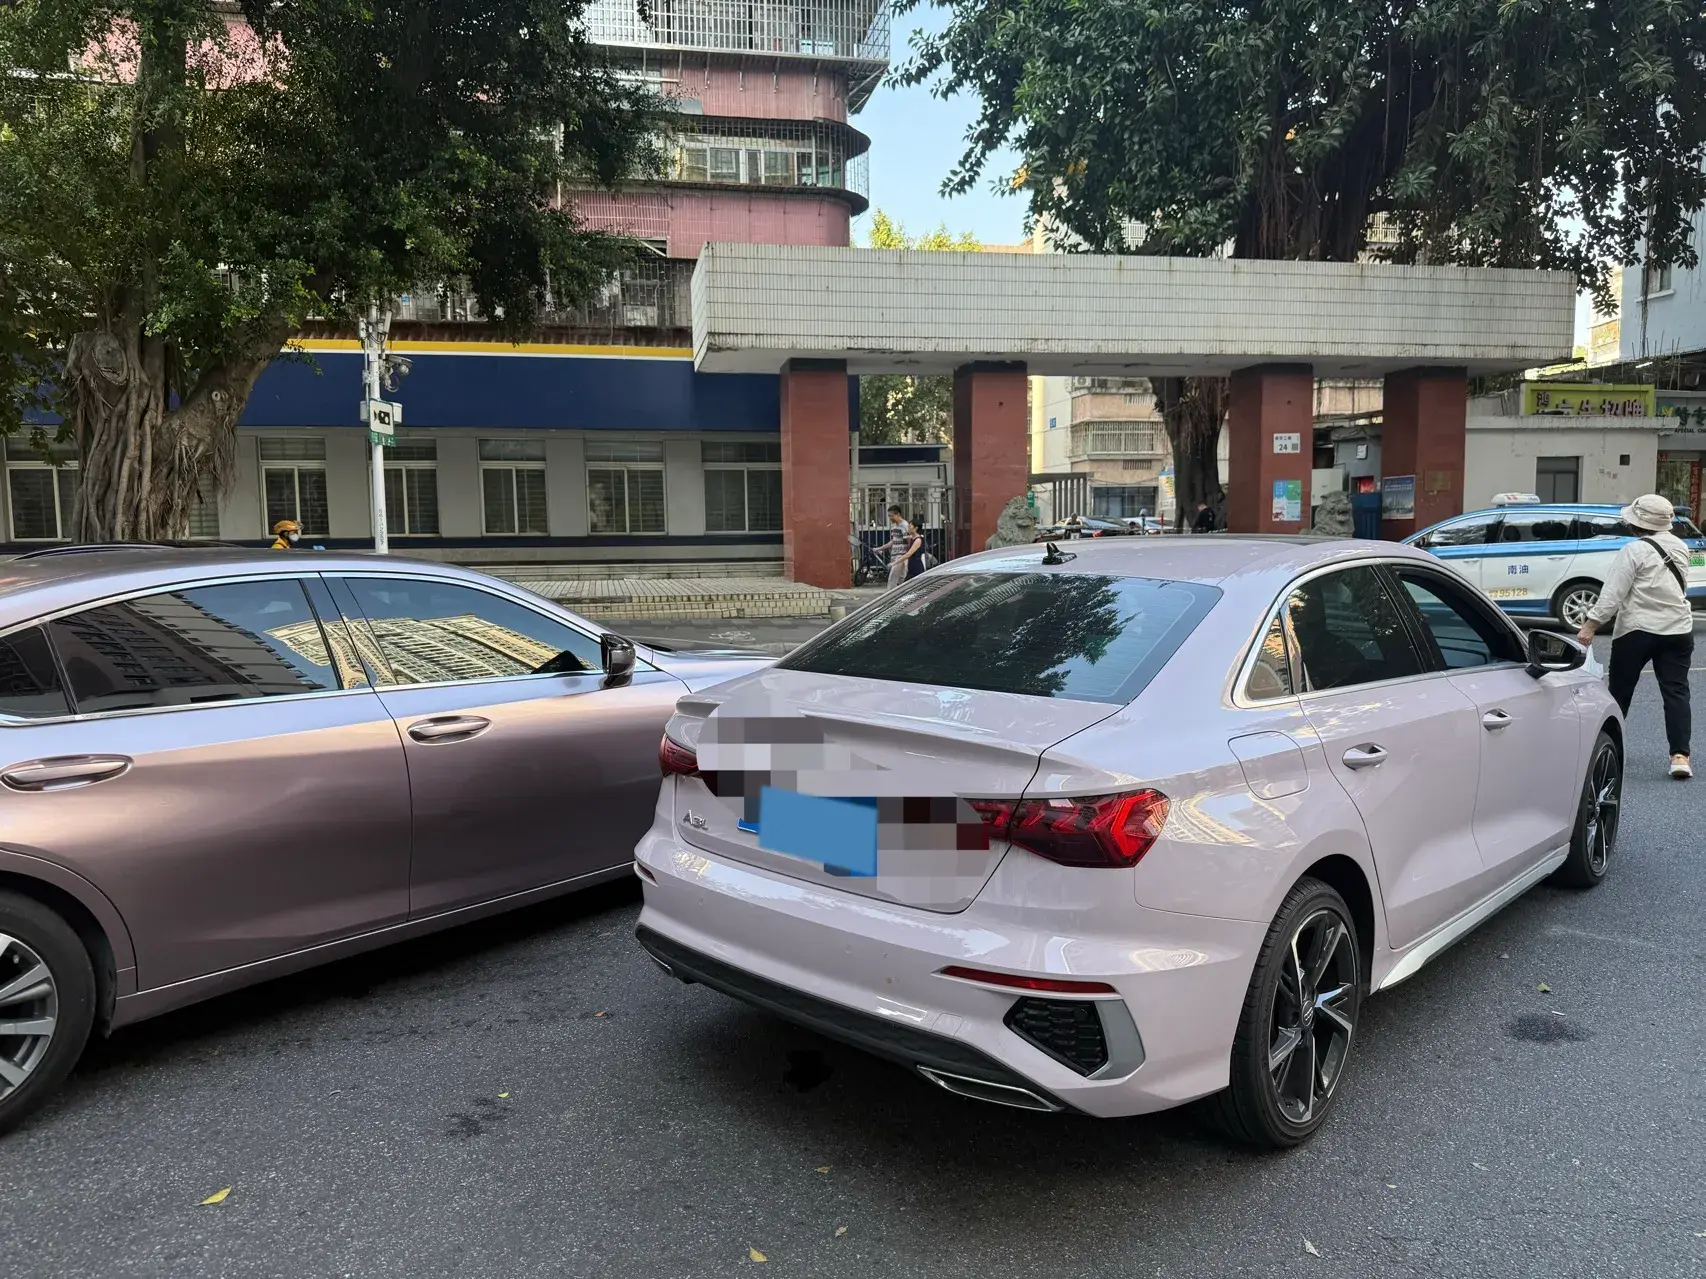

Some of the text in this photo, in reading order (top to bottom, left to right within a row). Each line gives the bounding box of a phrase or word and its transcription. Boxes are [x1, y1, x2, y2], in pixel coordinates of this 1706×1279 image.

[1278, 443, 1288, 451] 24
[1507, 564, 1529, 575] 南油
[1499, 587, 1528, 598] 95128
[683, 809, 708, 831] A3L
